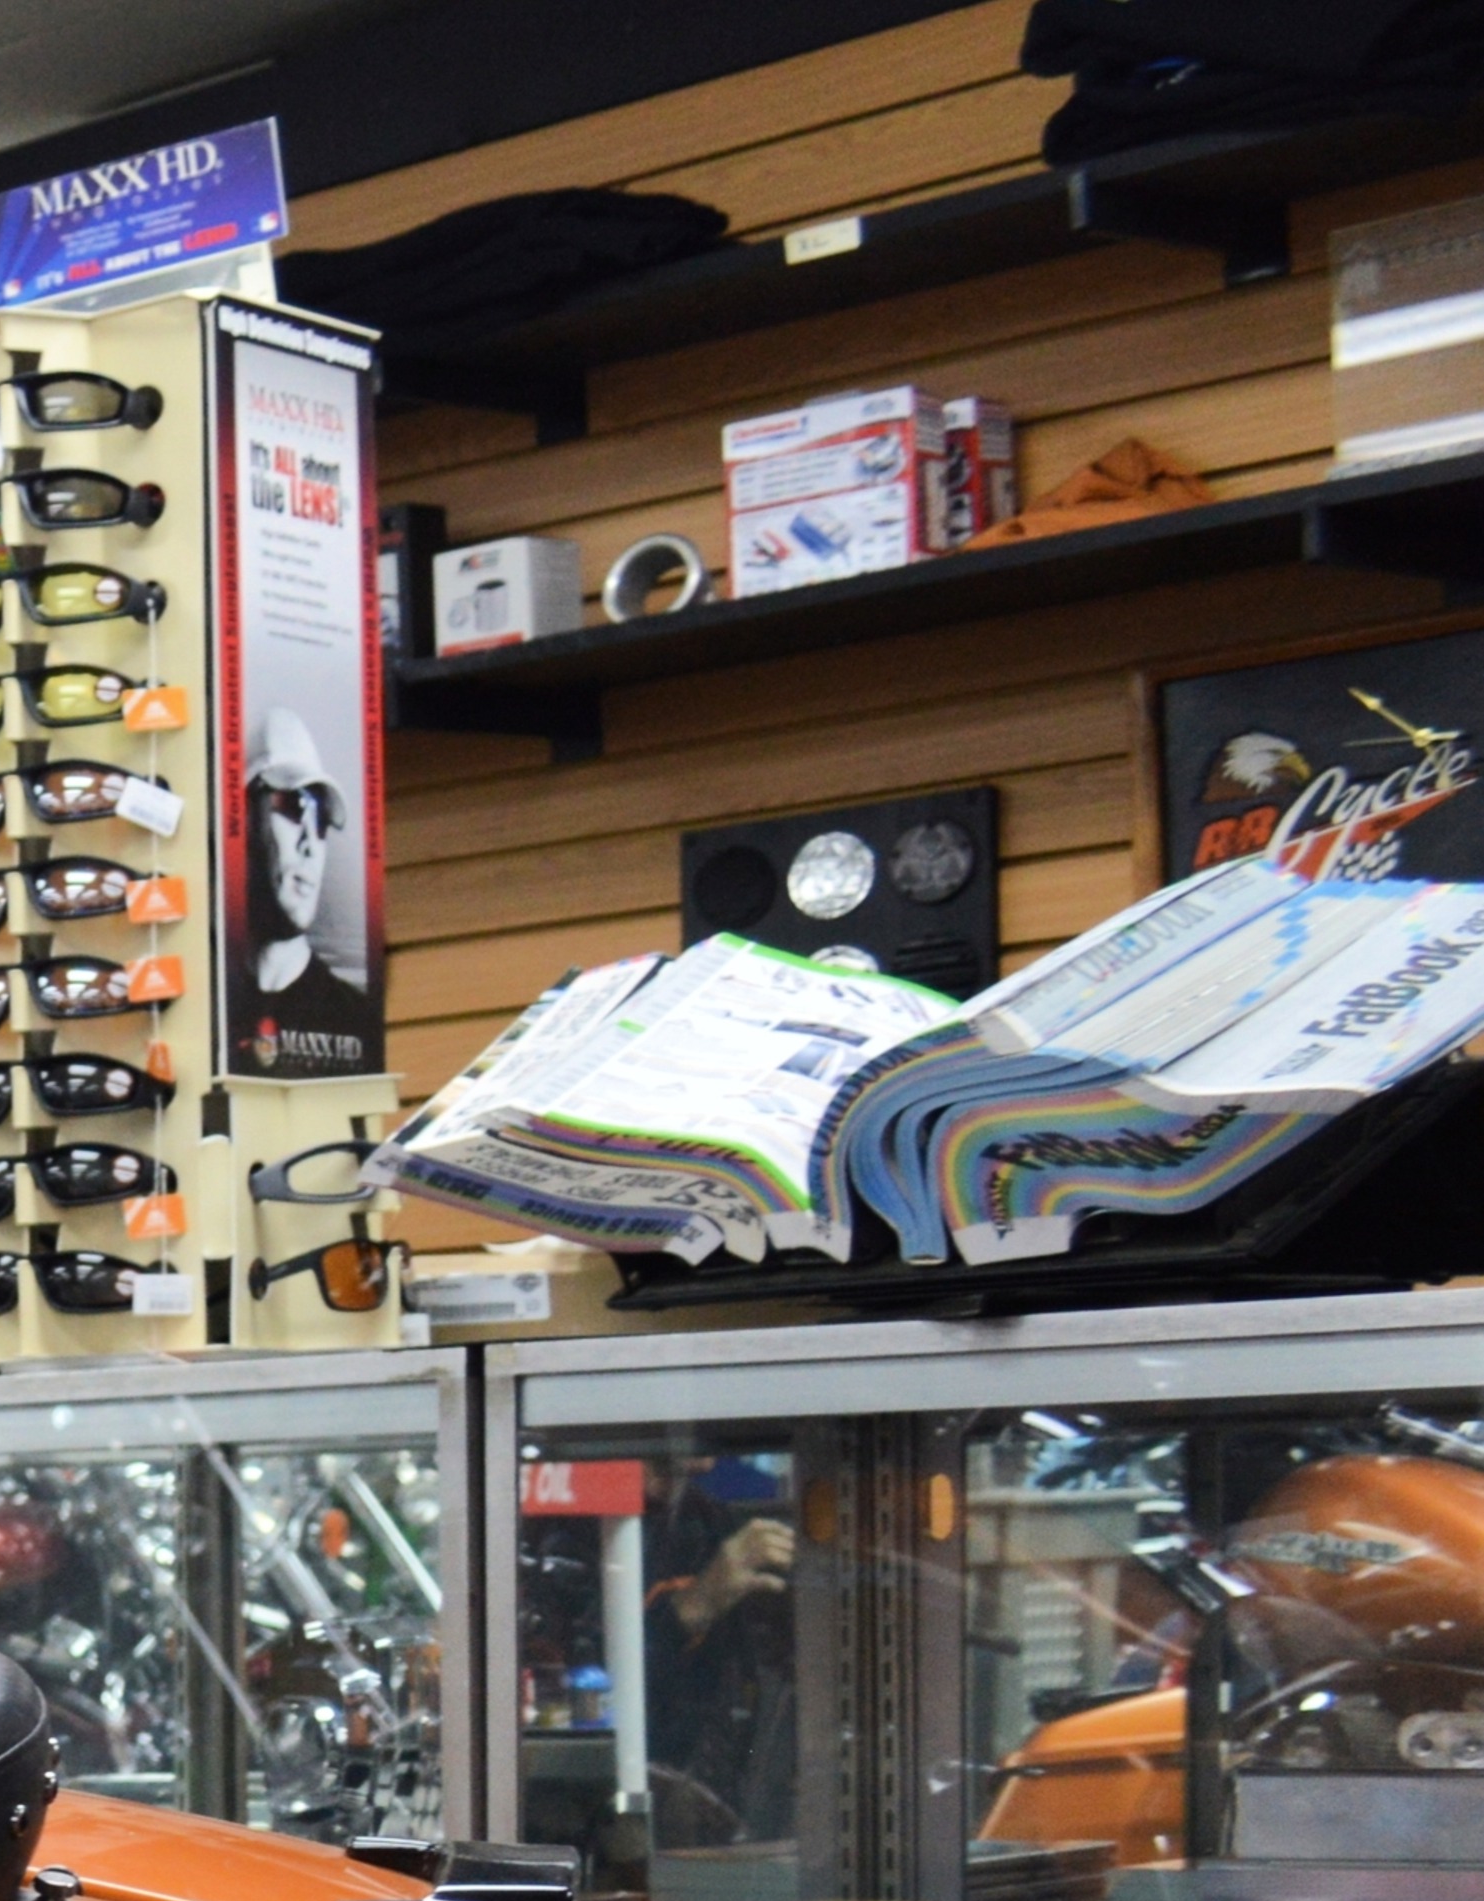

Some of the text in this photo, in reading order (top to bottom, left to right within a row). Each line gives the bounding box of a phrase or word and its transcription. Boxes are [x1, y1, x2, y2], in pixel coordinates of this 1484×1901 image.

[31, 161, 150, 219] MAXX
[156, 141, 219, 186] HD
[274, 445, 299, 477] ALL
[302, 453, 340, 486] about
[251, 473, 285, 514] the
[1263, 743, 1471, 882] Cycle
[1300, 936, 1483, 1038] FatBook
[281, 1028, 363, 1061] MAXX HD
[979, 1128, 1207, 1172] FatBook
[518, 1197, 600, 1231] SERVICE
